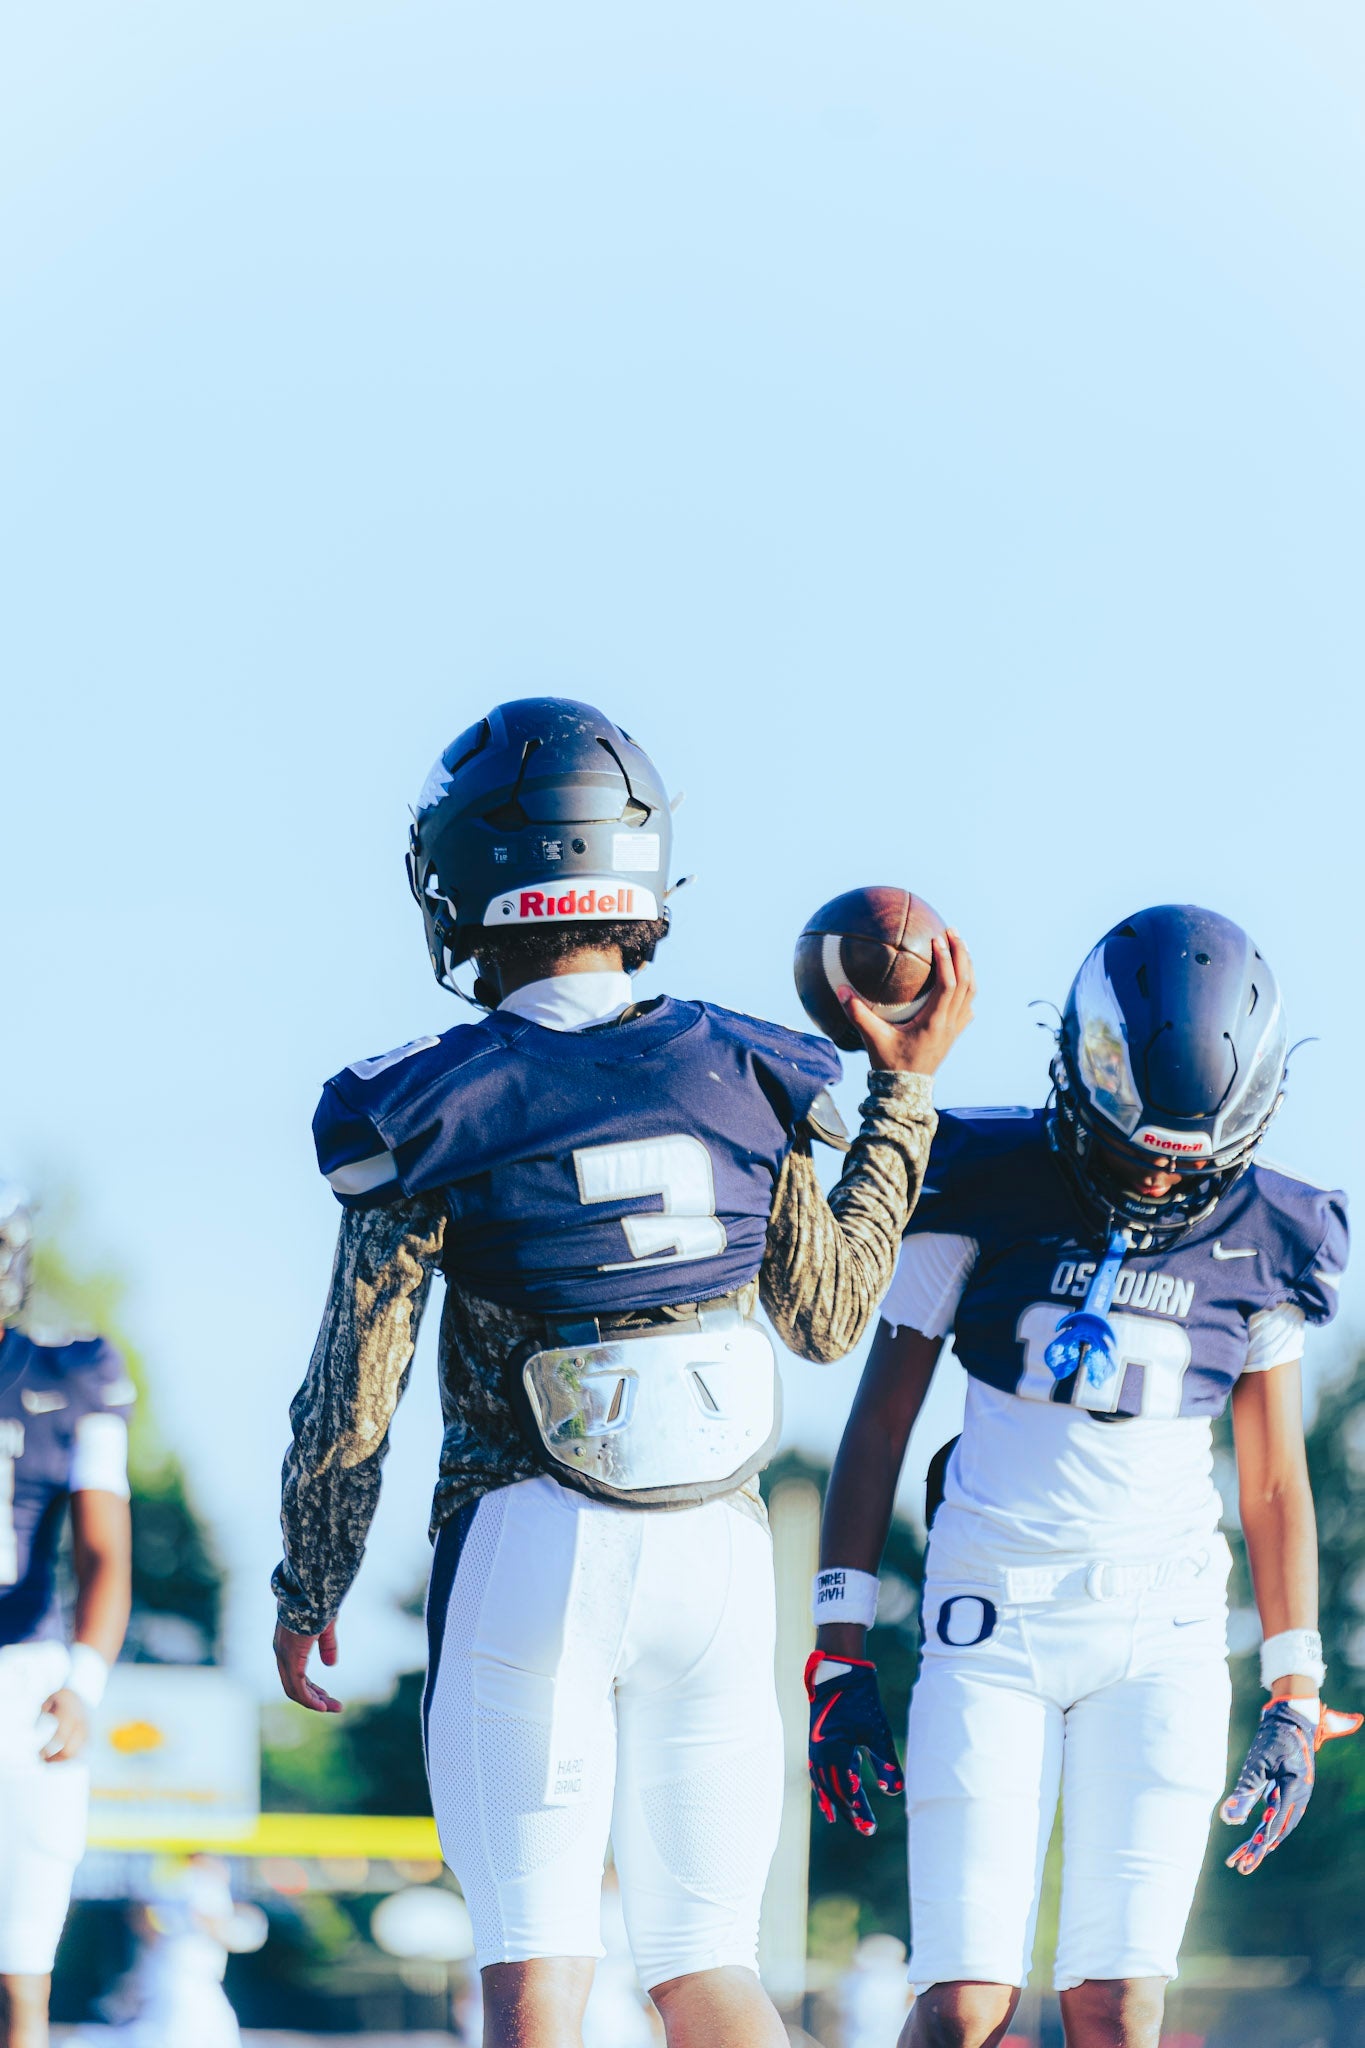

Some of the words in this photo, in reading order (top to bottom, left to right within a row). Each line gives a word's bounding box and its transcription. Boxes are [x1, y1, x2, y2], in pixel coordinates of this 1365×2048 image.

[520, 889, 633, 918] Riddell
[1143, 1133, 1203, 1152] Riddell
[572, 1133, 728, 1272] 3
[1050, 1261, 1195, 1318] OSOURN
[937, 1595, 997, 1646] O
[558, 1759, 583, 1775] HARD
